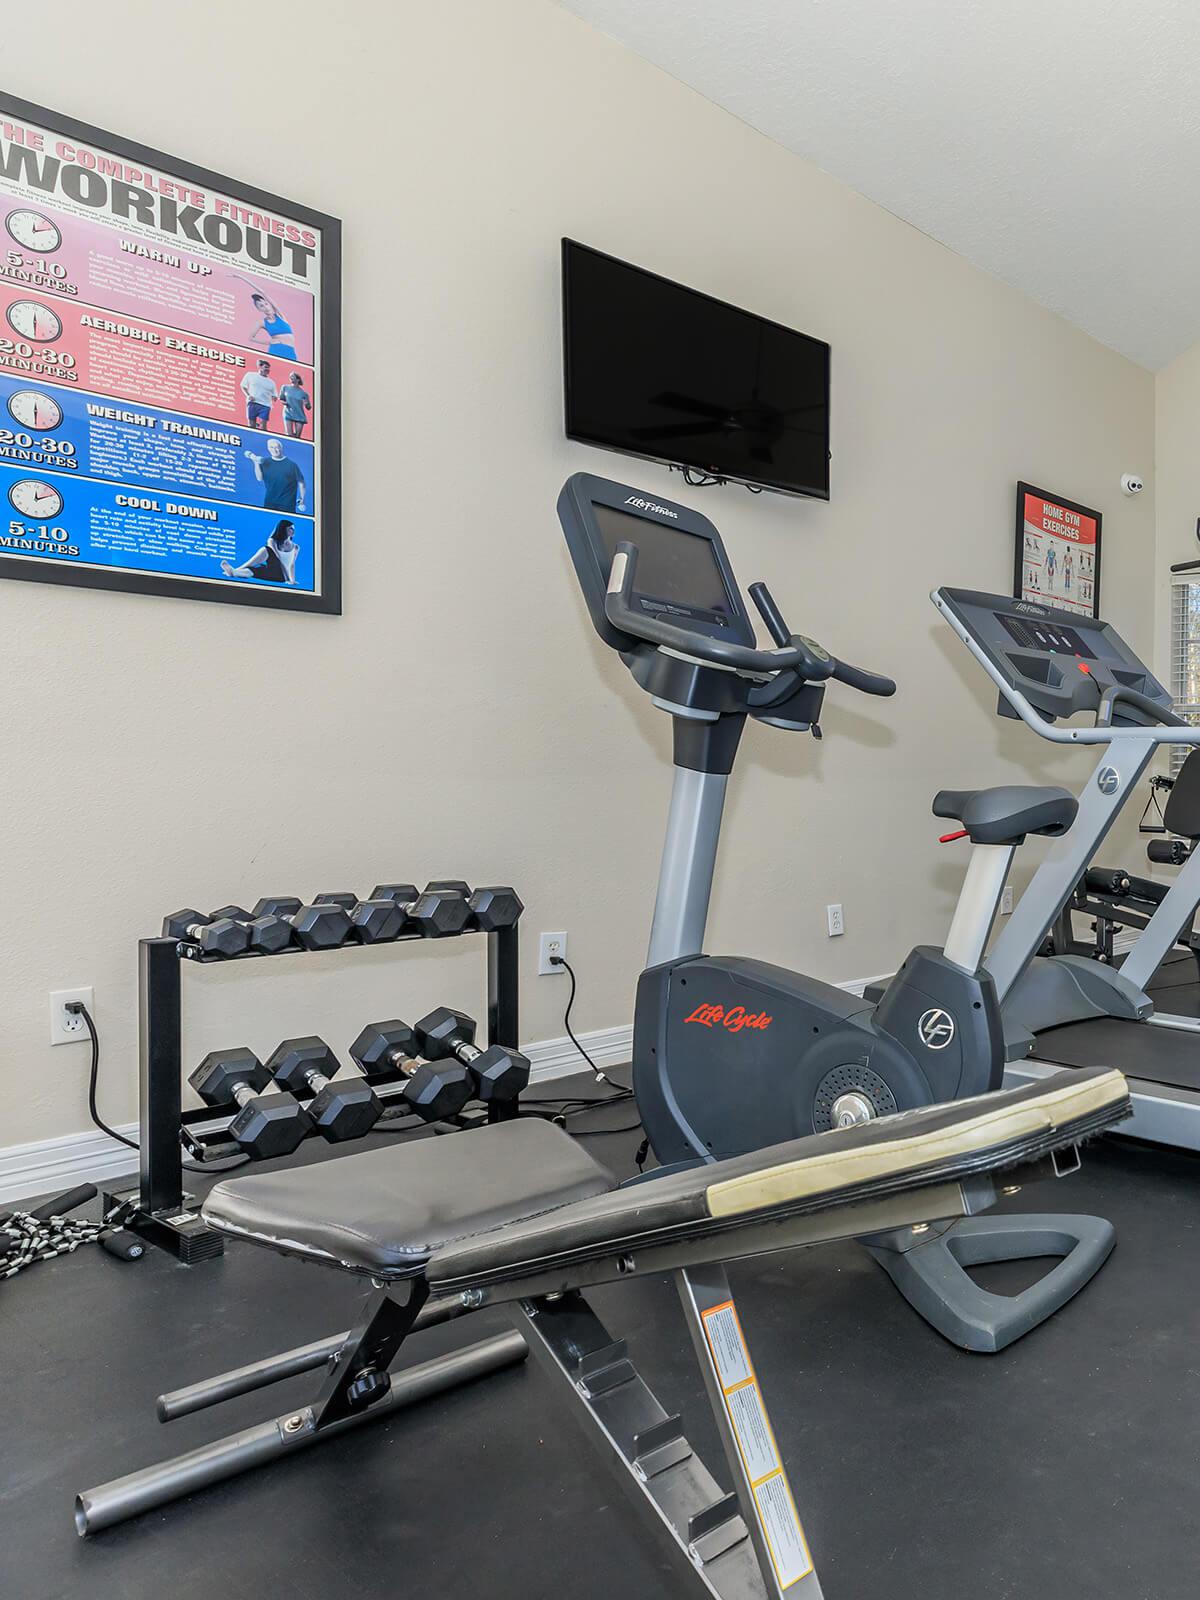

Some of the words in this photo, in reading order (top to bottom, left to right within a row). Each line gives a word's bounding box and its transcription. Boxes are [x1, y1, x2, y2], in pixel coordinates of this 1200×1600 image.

[0, 121, 44, 152] HE
[55, 141, 205, 209] COMPLETE
[215, 198, 317, 248] FITNESS
[0, 143, 316, 278] WORKOUT
[6, 250, 67, 279] 5-10
[120, 239, 181, 268] WARM
[188, 259, 213, 277] UP
[0, 338, 75, 368] 20-30
[80, 314, 160, 345] AEROBIC
[165, 336, 246, 368] EXERCISE
[0, 355, 78, 382] MINUTES
[86, 403, 157, 428] WEIGHT
[160, 419, 242, 447] TRAINING
[0, 429, 75, 456] 20-30
[0, 445, 78, 469] MINUTES
[115, 494, 162, 512] COOL
[166, 502, 218, 521] DOWN
[1043, 503, 1063, 520] HOME
[1065, 511, 1080, 526] GYM
[8, 521, 68, 543] 5-10
[1042, 518, 1080, 540] EXERCISES
[0, 535, 79, 556] MINUTES
[684, 1003, 724, 1028] Life
[723, 1006, 773, 1033] Cycle
